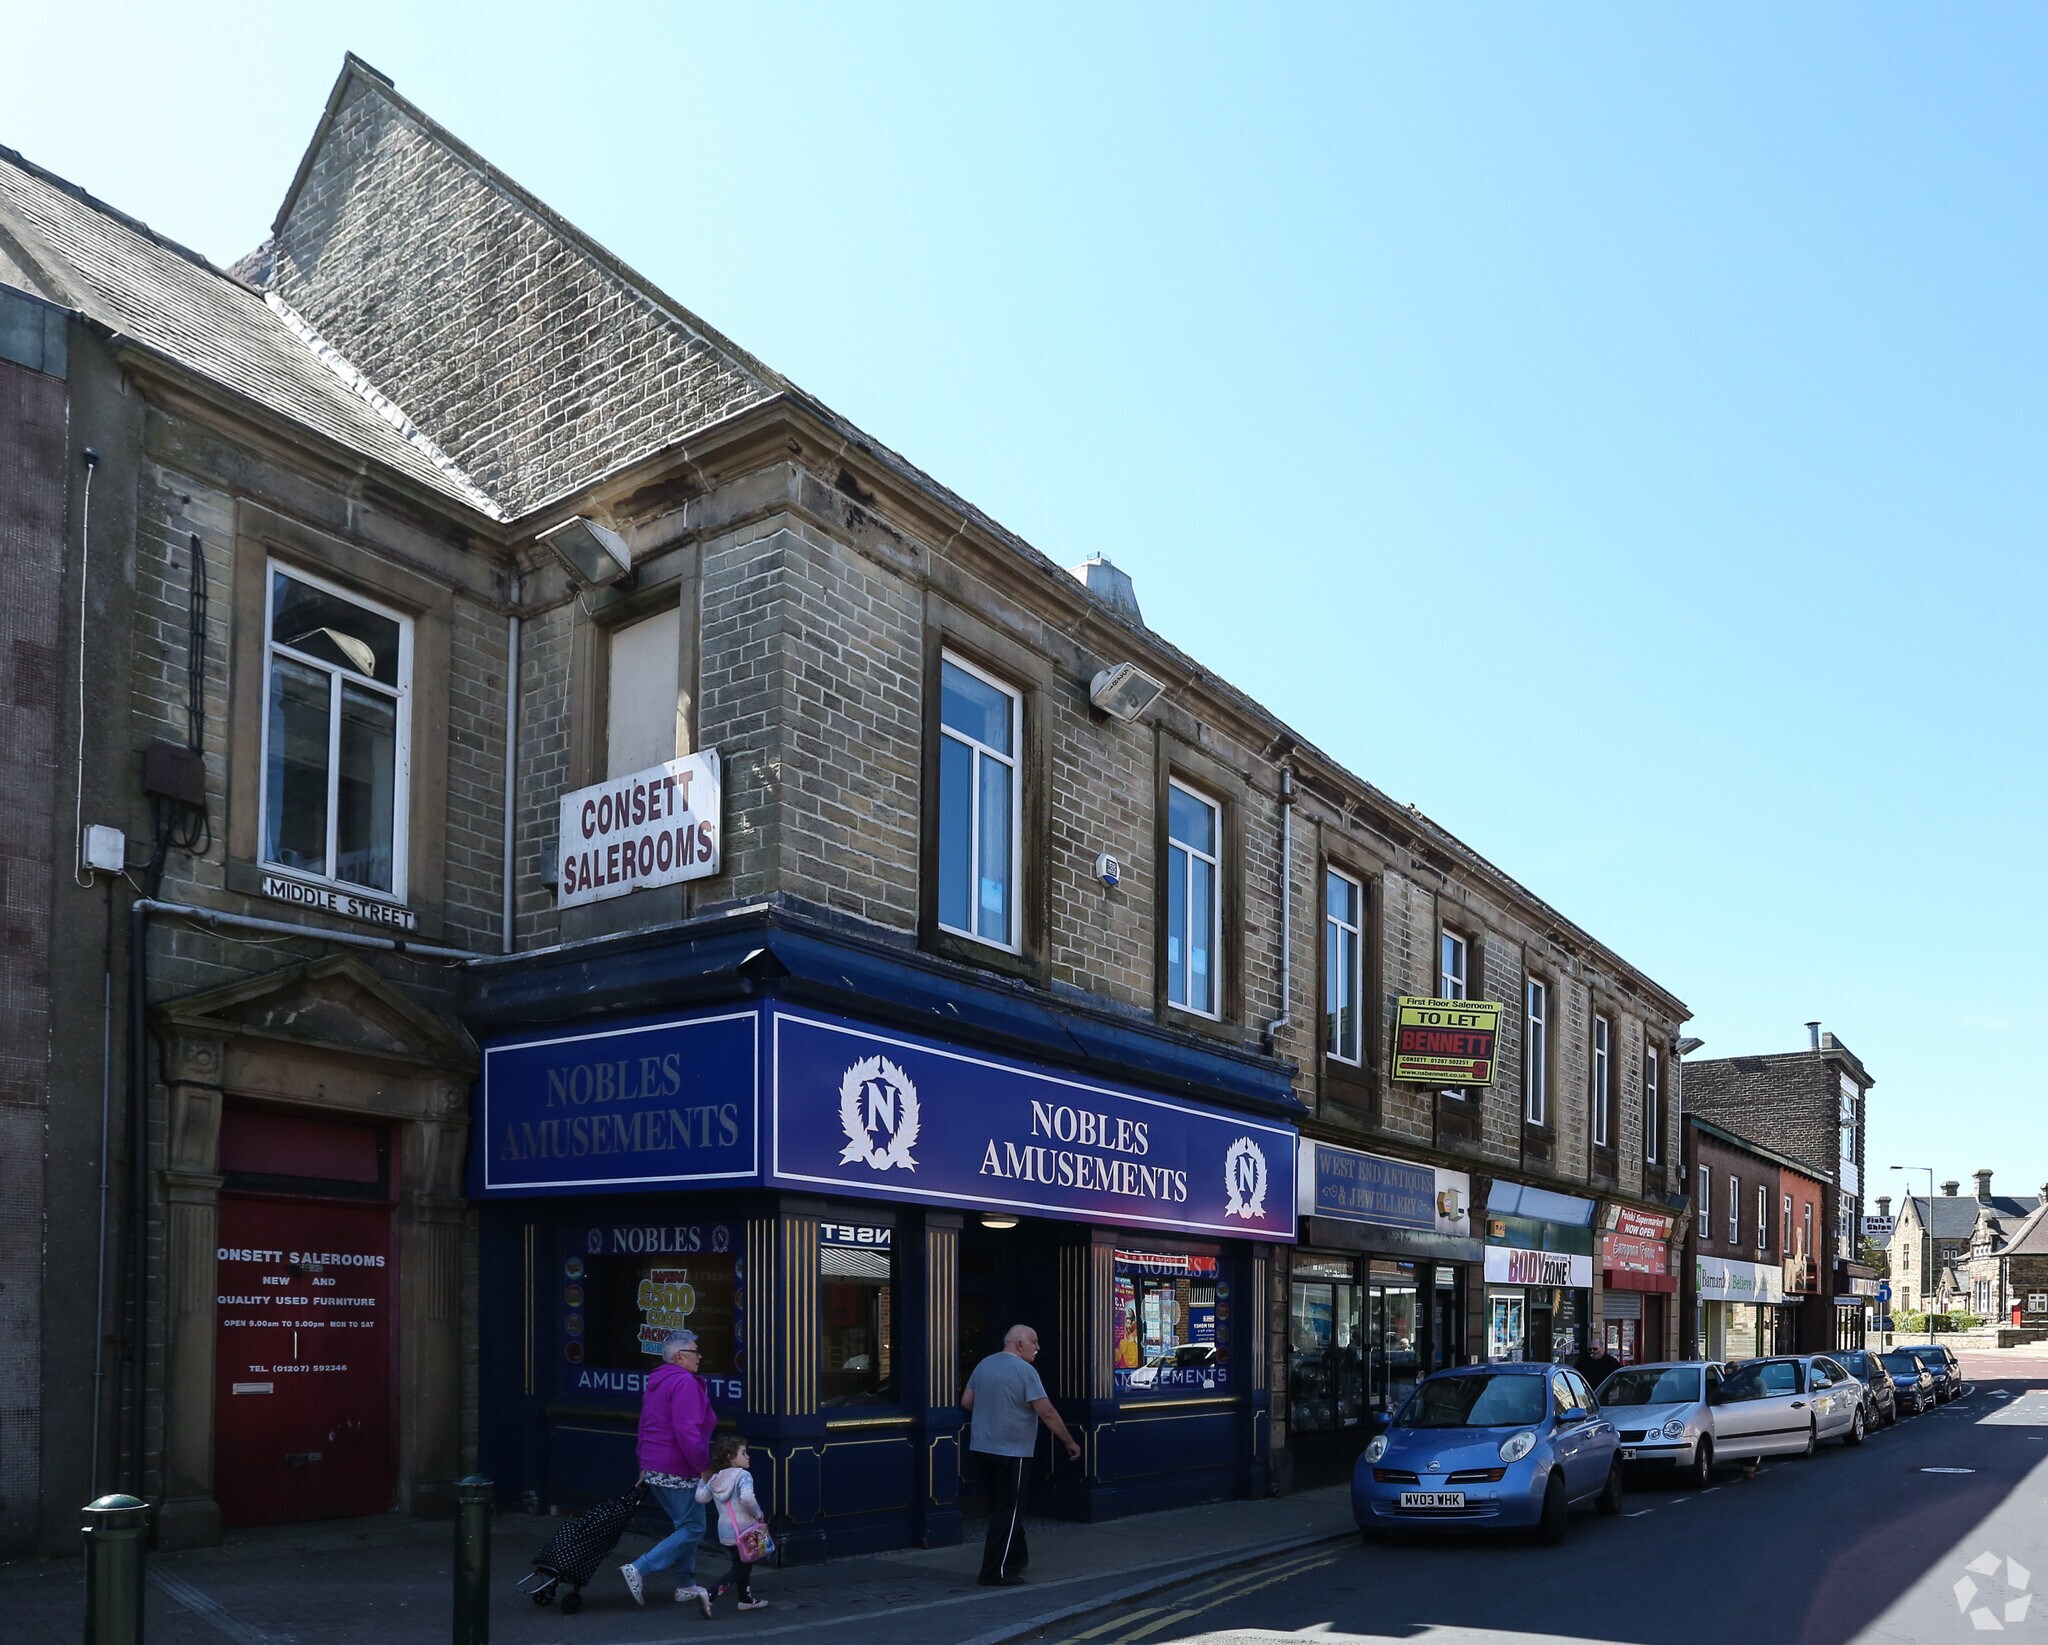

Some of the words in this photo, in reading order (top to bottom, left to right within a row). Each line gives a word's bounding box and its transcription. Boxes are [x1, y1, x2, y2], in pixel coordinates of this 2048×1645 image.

[581, 770, 693, 839] CONSETT
[564, 820, 713, 895] SALEROOMS
[270, 879, 337, 911] MIDDLE
[348, 899, 412, 929] STREET
[1406, 997, 1425, 1006] First
[1428, 999, 1449, 1008] Floor
[1452, 1000, 1493, 1010] Saleroom
[1417, 1012, 1441, 1025] TO
[1447, 1014, 1480, 1027] LET
[1402, 1030, 1490, 1055] BENNETT
[546, 1053, 681, 1107] NOBLES
[865, 1081, 897, 1134] N
[500, 1103, 738, 1161] AMUSEMENTS
[1031, 1100, 1148, 1156] NOBLES
[979, 1138, 1187, 1202] AMUSEMENTS
[1239, 1156, 1254, 1193] N
[1319, 1153, 1355, 1179] WEST
[1358, 1160, 1381, 1183] END
[1383, 1166, 1433, 1195] ANTIQUES
[1338, 1185, 1347, 1206] &
[1350, 1187, 1417, 1216] JEWELLERY
[1621, 1209, 1637, 1222] Polski
[1636, 1213, 1664, 1228] Supermarket
[1624, 1223, 1639, 1236] NOW
[1639, 1226, 1656, 1238] OPEN
[1866, 1223, 1892, 1231] Chips
[613, 1226, 701, 1253] NOBLES
[289, 1252, 386, 1267] SALEROOMS
[1508, 1249, 1546, 1284] BODY
[1543, 1260, 1568, 1286] ZONE
[262, 1276, 290, 1286] NEW
[312, 1277, 336, 1286] AND
[217, 1296, 270, 1304] QUALITY
[275, 1296, 308, 1305] USED
[313, 1297, 375, 1306] FURNITURE
[639, 1281, 693, 1313] £500
[295, 1320, 325, 1330] 5.00pm
[647, 1310, 682, 1327] CASH
[272, 1364, 310, 1373] (01207)
[313, 1364, 347, 1372] 592346
[1405, 1494, 1435, 1506] MV03
[1437, 1494, 1460, 1506] WHK
